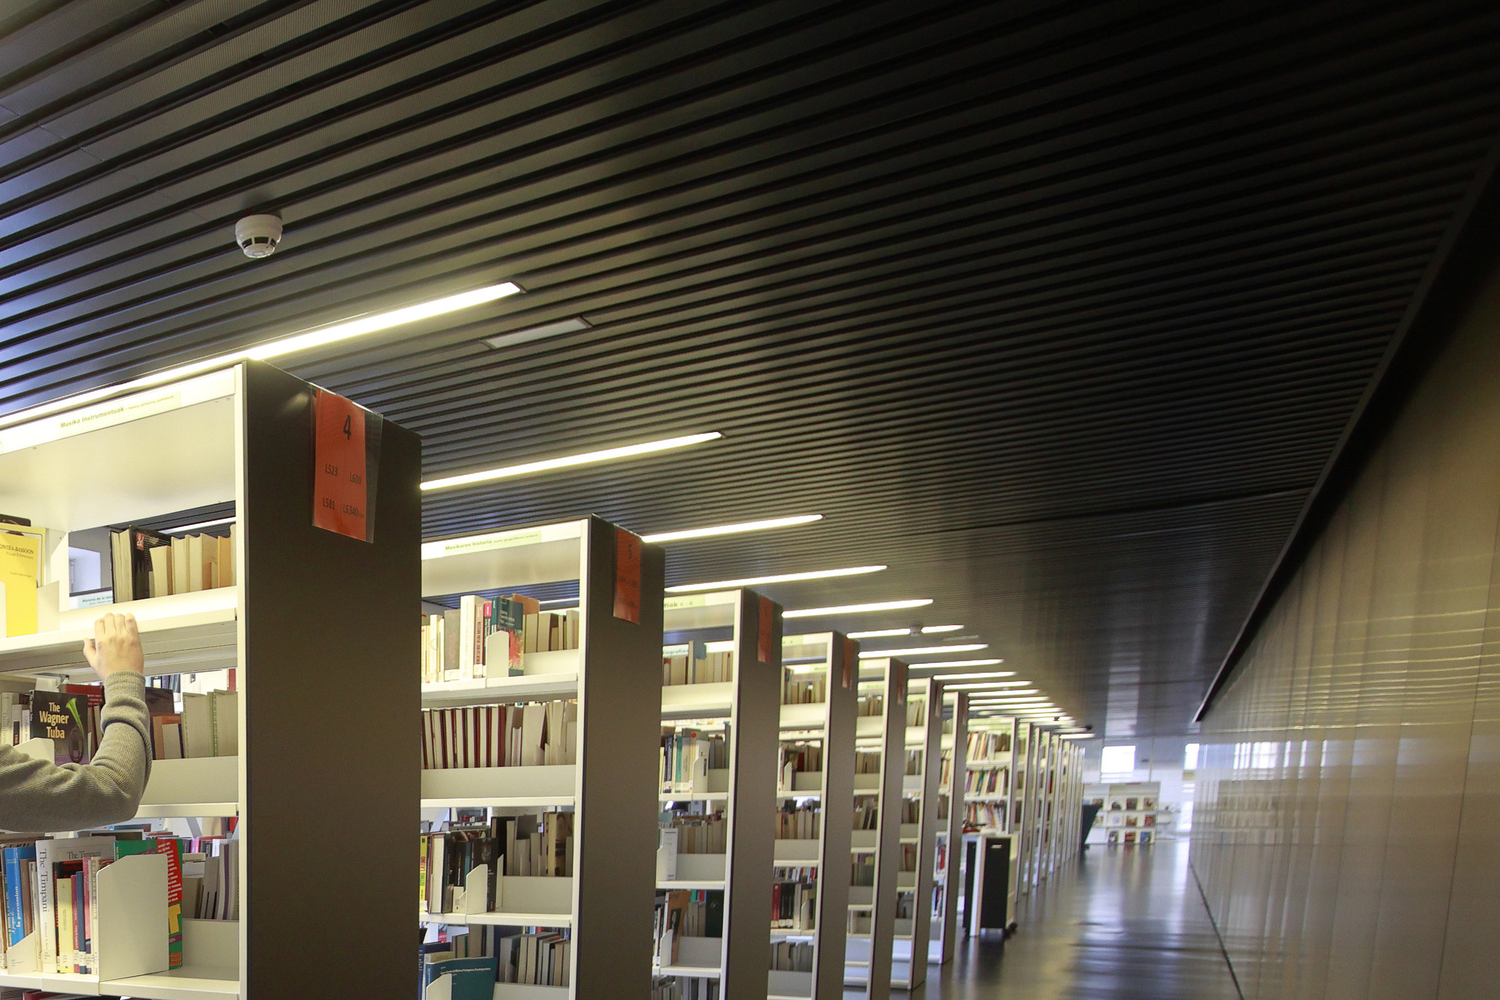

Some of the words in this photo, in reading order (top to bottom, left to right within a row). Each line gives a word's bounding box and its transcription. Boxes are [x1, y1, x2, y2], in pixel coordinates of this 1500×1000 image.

[343, 414, 352, 440] 4
[325, 463, 338, 477] L523
[49, 702, 60, 712] The
[39, 711, 69, 726] Wagner
[46, 727, 65, 739] Tuba
[68, 851, 78, 860] The
[40, 871, 50, 912] Timpani
